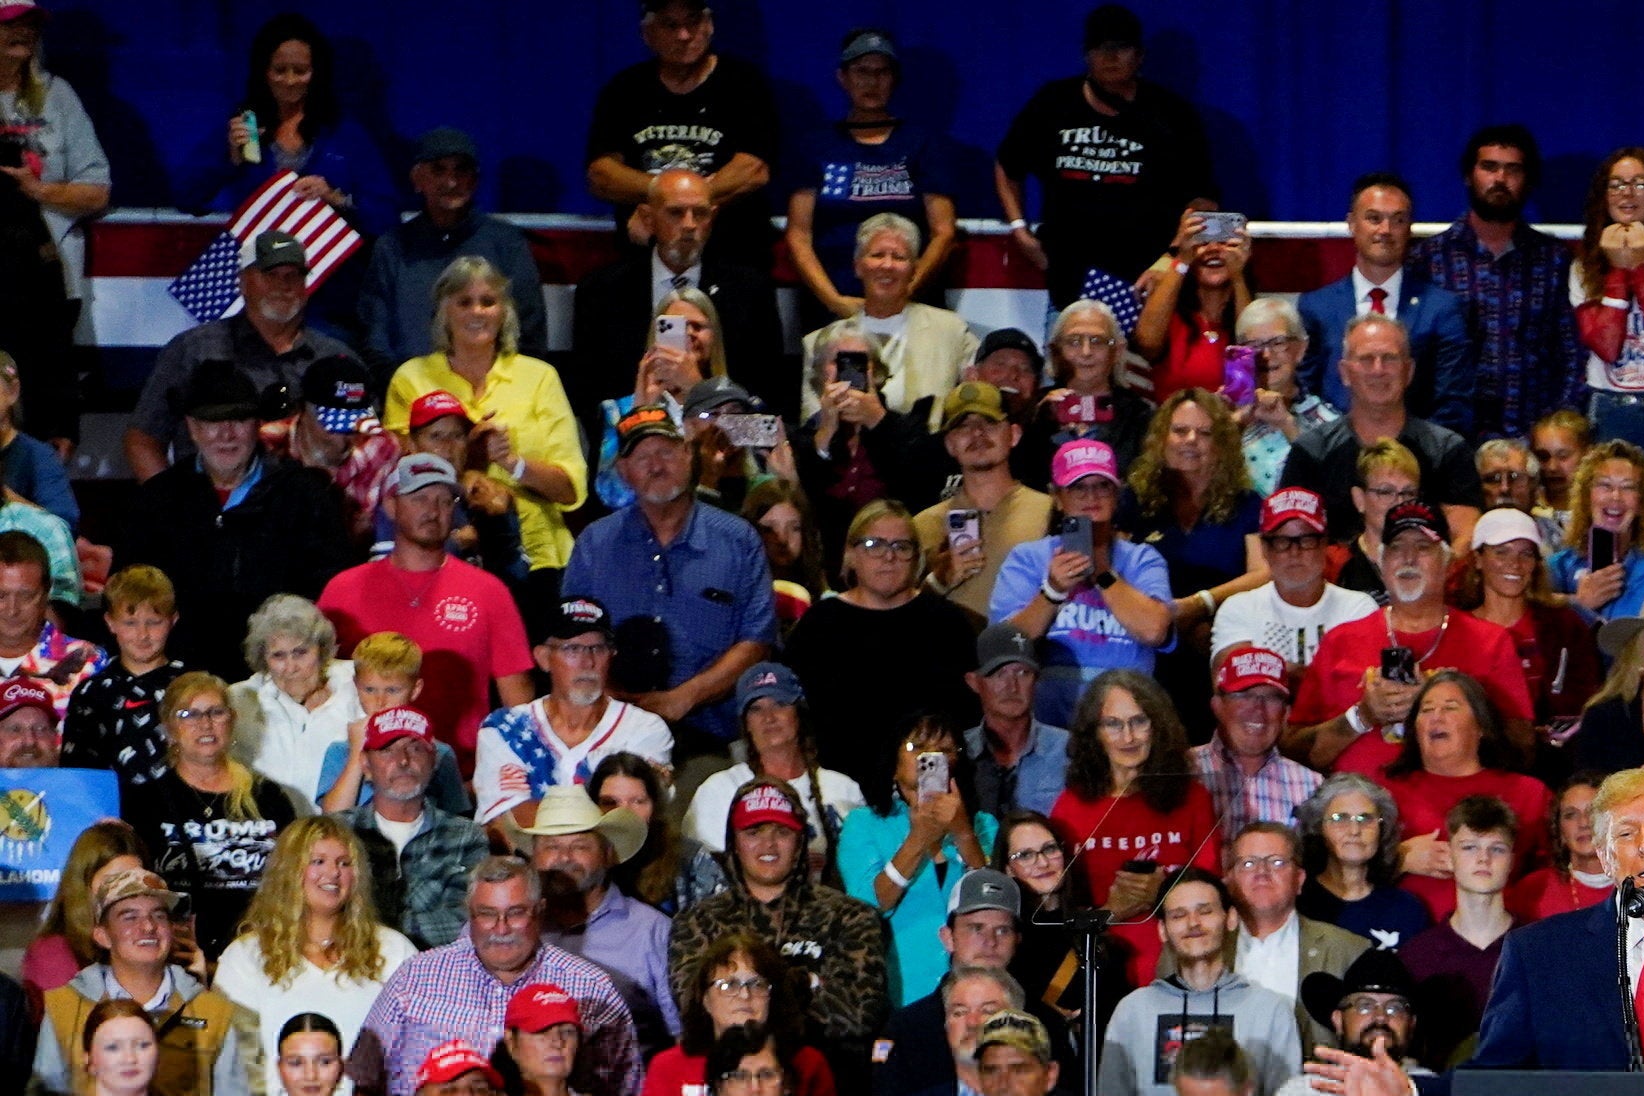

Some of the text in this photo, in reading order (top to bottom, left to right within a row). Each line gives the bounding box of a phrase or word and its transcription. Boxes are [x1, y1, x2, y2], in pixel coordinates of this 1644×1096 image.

[633, 125, 724, 146] VETERANS
[1056, 156, 1144, 175] PRESIDENT
[1063, 446, 1113, 469] TRUMP
[1057, 602, 1127, 637] RUM
[160, 818, 277, 842] TRUMP
[0, 868, 60, 885] LAHOM
